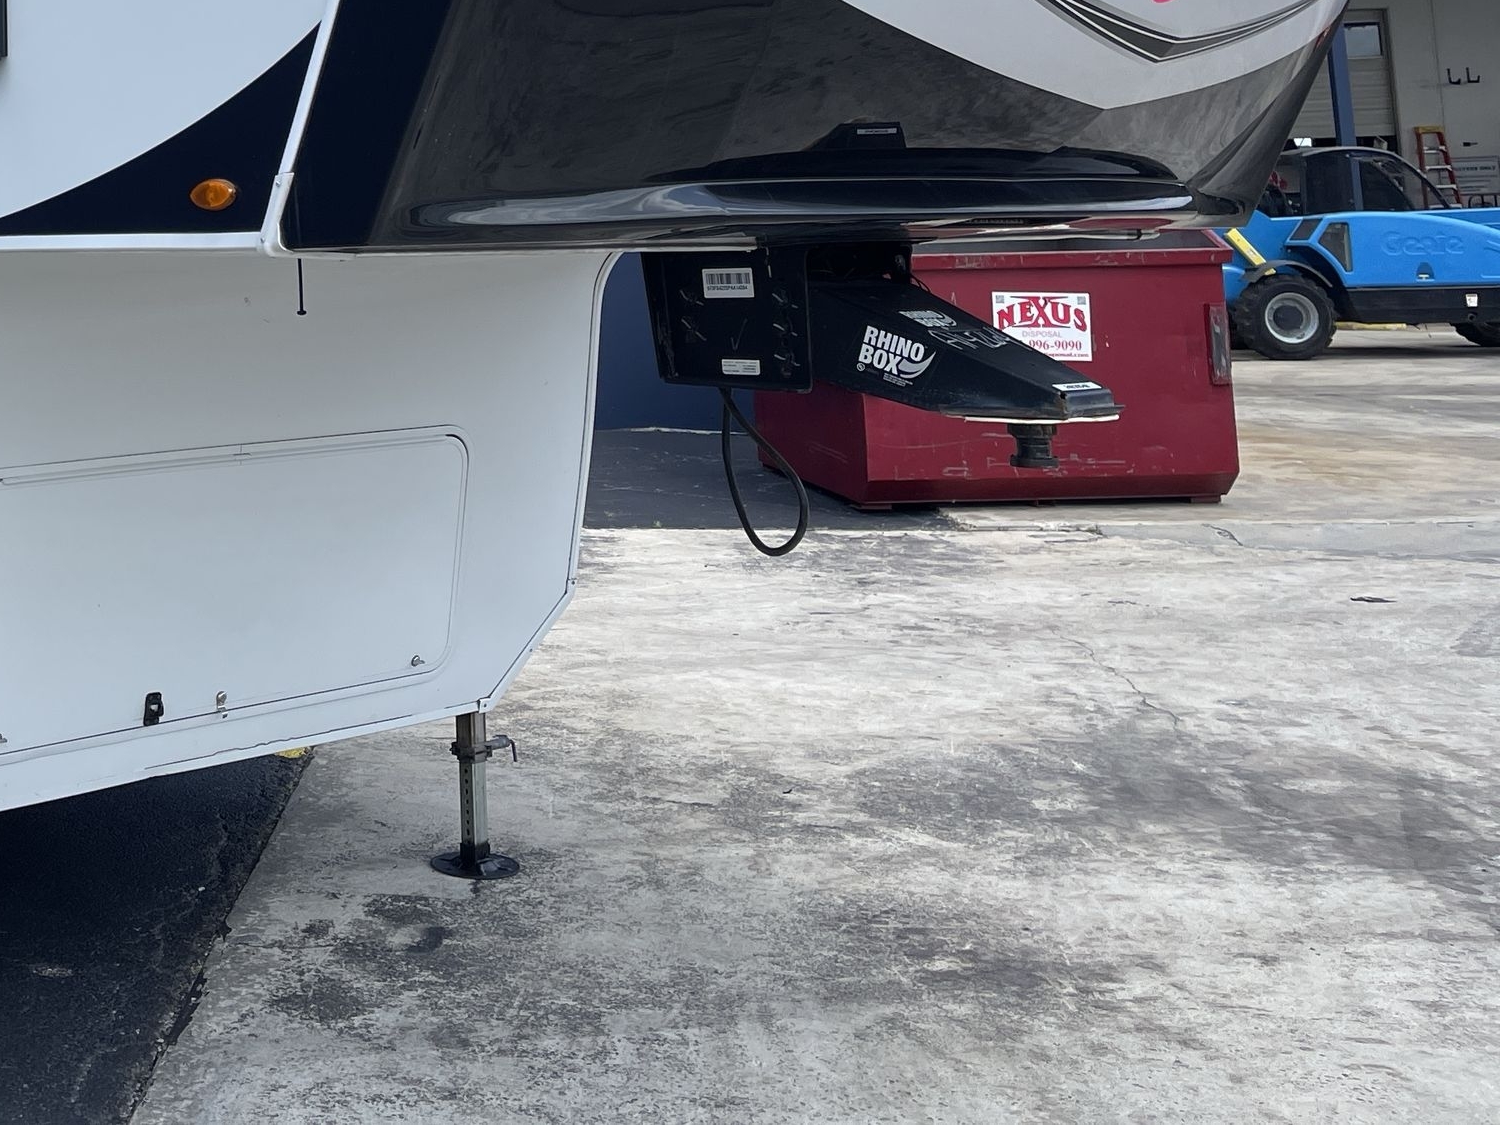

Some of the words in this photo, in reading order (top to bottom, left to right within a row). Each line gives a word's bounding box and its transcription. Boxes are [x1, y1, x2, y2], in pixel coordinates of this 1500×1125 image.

[1381, 231, 1464, 256] Genie
[996, 296, 1088, 333] NEXUS
[857, 343, 902, 376] BOX
[863, 325, 925, 362] RHINO
